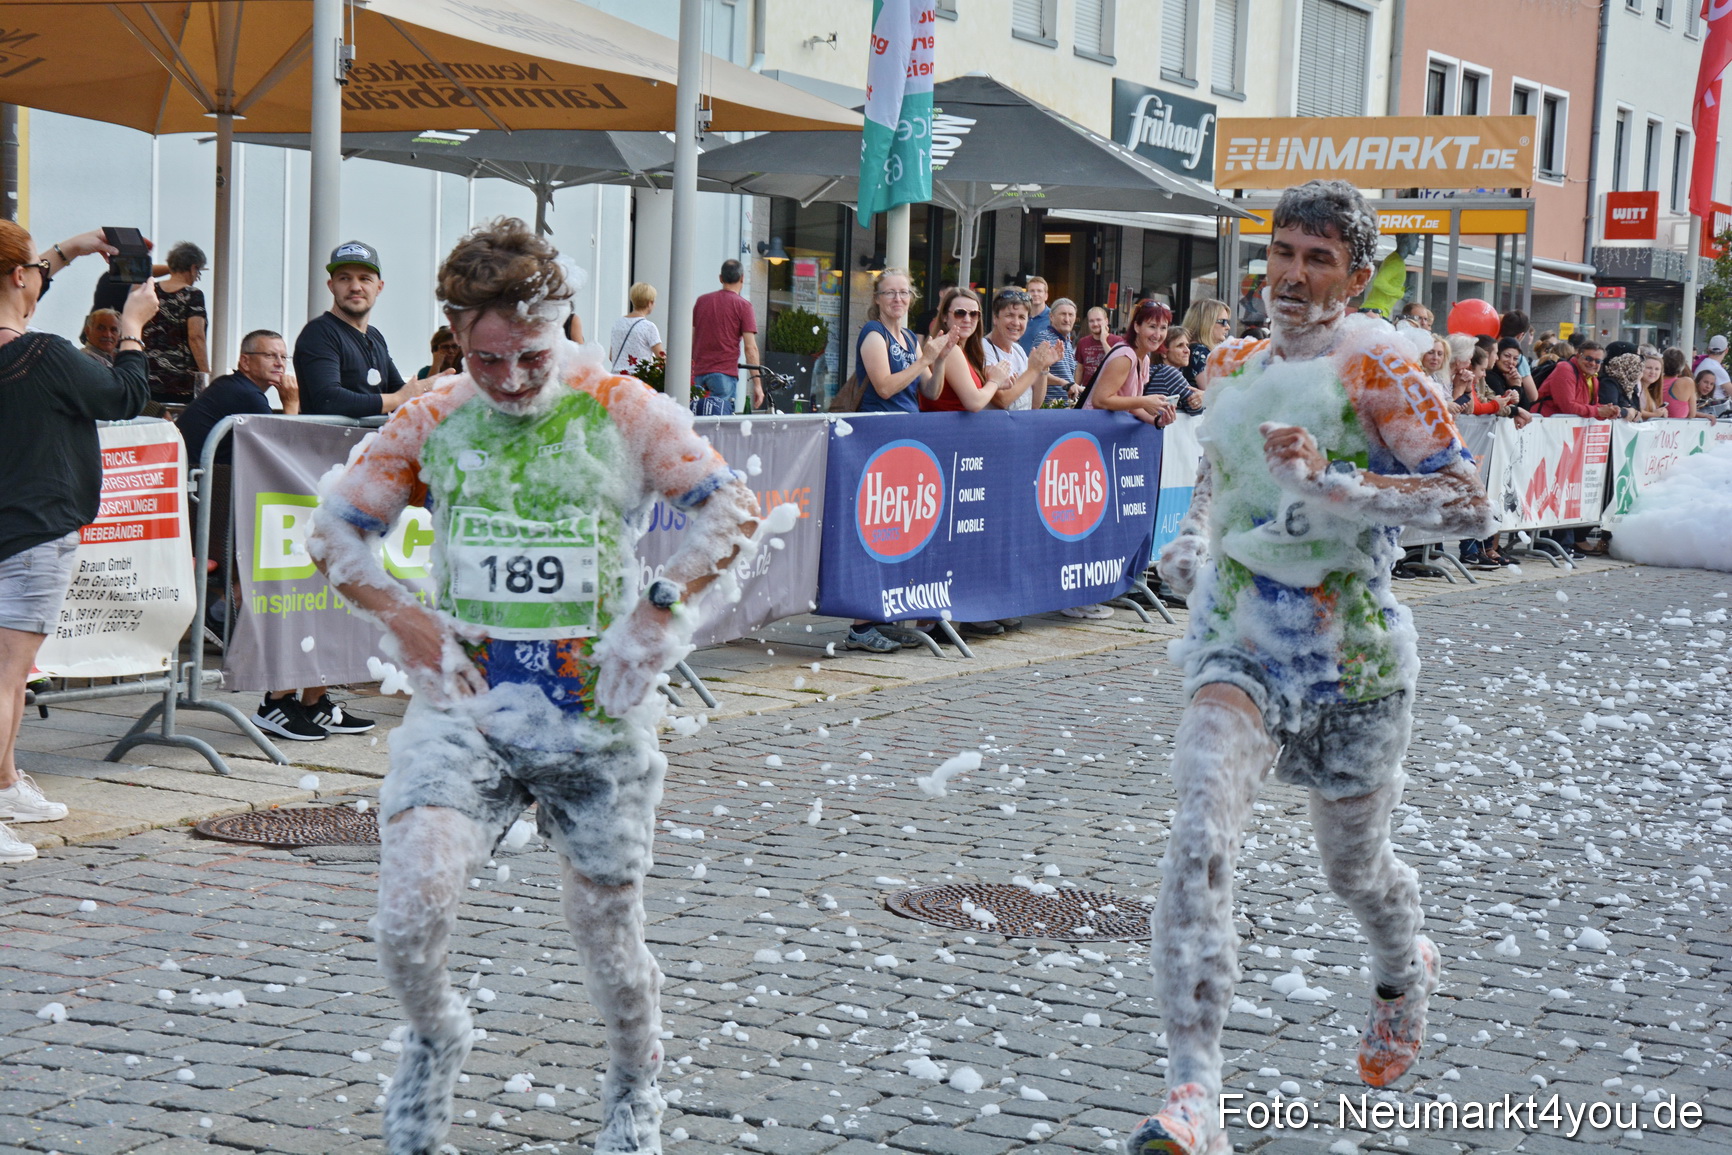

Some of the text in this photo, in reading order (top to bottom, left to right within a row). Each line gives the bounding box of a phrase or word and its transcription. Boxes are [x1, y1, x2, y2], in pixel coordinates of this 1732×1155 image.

[1121, 94, 1215, 170] frühauf
[1225, 136, 1518, 171] RUNMARKT.DE
[1377, 214, 1440, 229] ARKT.DE
[1612, 207, 1648, 220] WITT
[101, 450, 136, 466] TRICKE
[1118, 447, 1139, 460] STORE
[960, 457, 984, 471] STORE
[101, 472, 164, 492] RRSYSTEME
[1044, 459, 1104, 515] Hervis
[1121, 475, 1145, 488] ONLINE
[865, 472, 937, 533] Hervis
[958, 487, 985, 502] ONLINE
[1051, 508, 1075, 523] SPORTS
[1122, 502, 1146, 516] MOBILE
[83, 523, 144, 542] HEBEBÄNDER
[957, 518, 985, 533] MOBILE
[871, 527, 901, 543] SPORTS
[79, 557, 132, 572] Braun GmbH
[71, 572, 138, 589] Am Grünberg 8
[479, 555, 565, 594] 189
[1061, 563, 1083, 591] GET
[65, 587, 180, 602] D-92318 Neumarkt-Pölling
[252, 585, 328, 619] inspired
[882, 587, 904, 617] GET
[60, 608, 74, 623] Tel.
[75, 608, 103, 621] 09181
[108, 609, 144, 620] 2307-0
[56, 625, 73, 639] Fax
[74, 622, 96, 637] 09181
